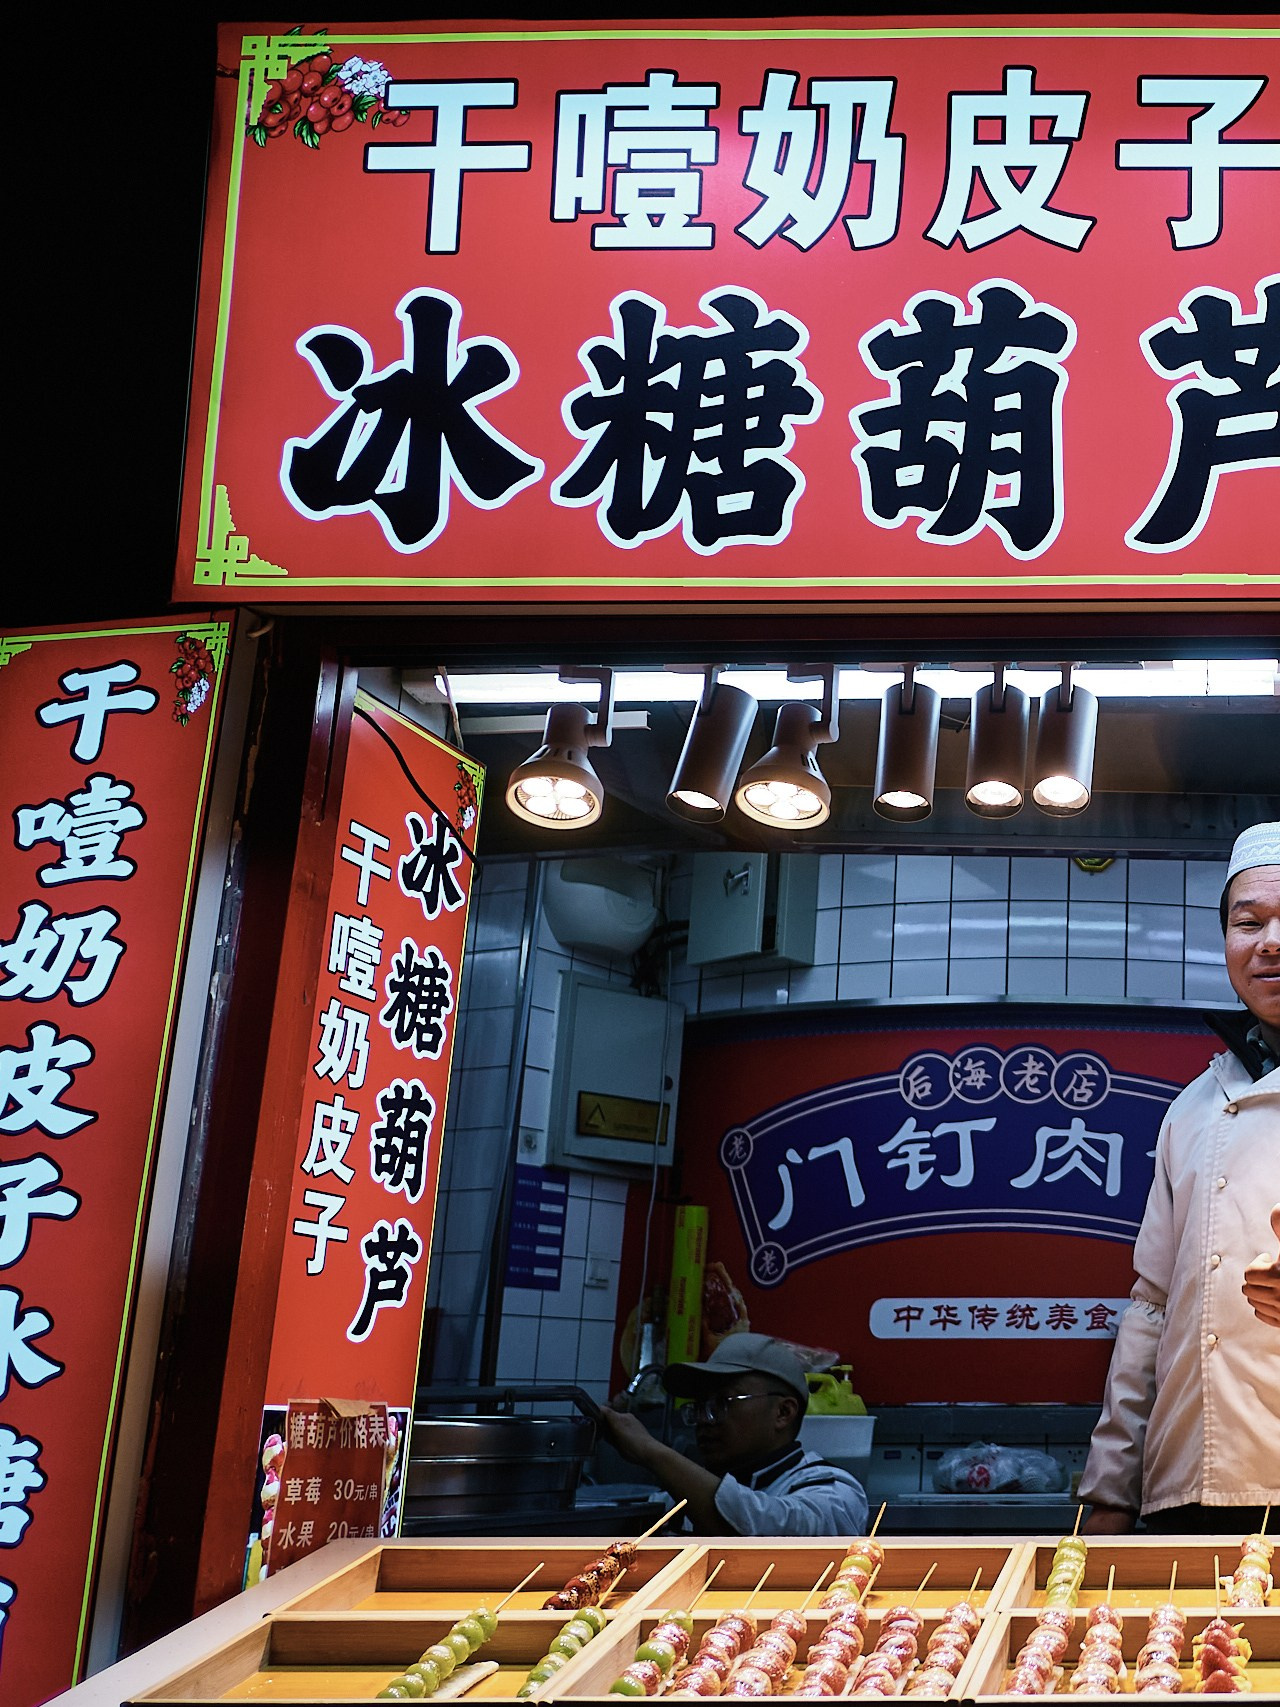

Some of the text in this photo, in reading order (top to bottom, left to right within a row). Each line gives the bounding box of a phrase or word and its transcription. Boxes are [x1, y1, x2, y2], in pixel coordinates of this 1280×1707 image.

[294, 819, 392, 1278] 干噎奶皮子
[346, 810, 467, 1344] 冰糖葫芦
[904, 1054, 1099, 1104] 后海老店
[767, 1116, 1155, 1231] 门钉肉
[893, 1303, 1117, 1332] 中华传统美食
[289, 1411, 387, 1449] 糖葫芦价格表
[285, 1477, 378, 1505] 草莓 30元/串
[277, 1520, 314, 1549] 水果
